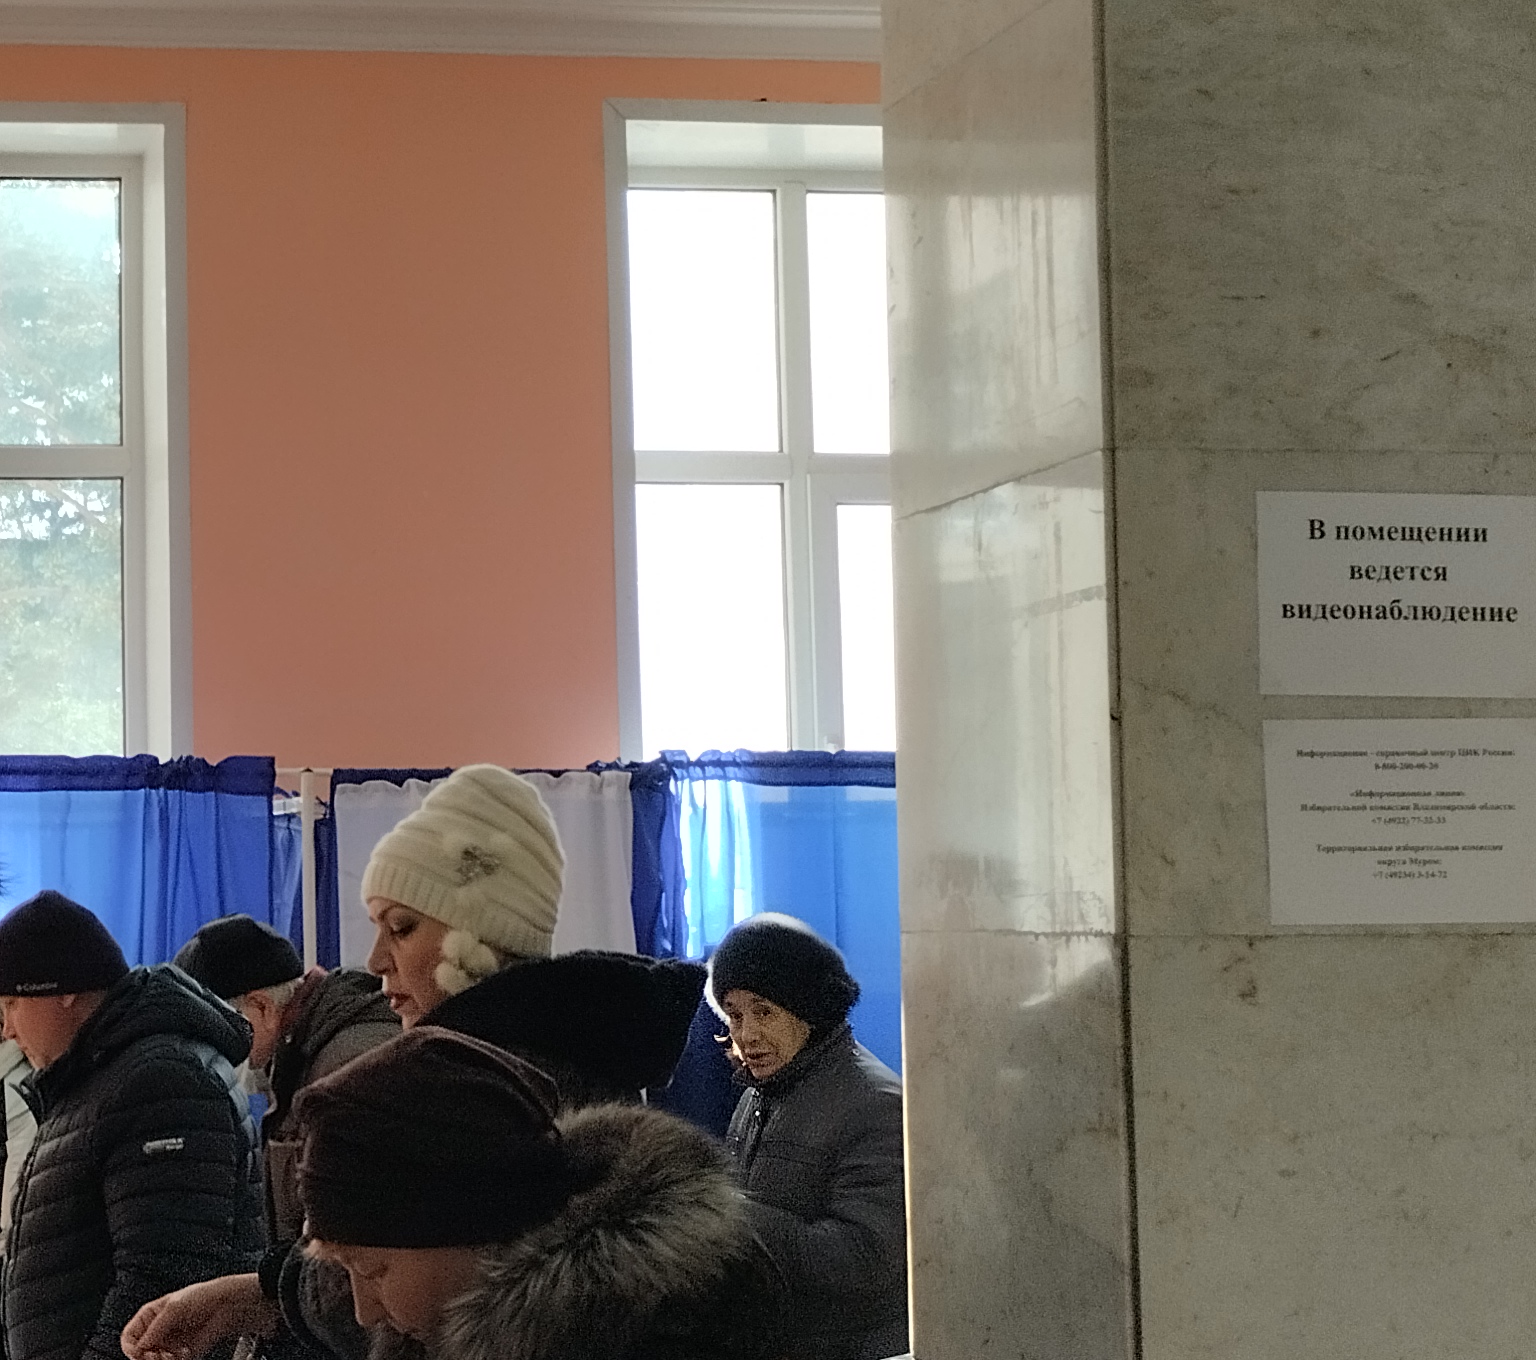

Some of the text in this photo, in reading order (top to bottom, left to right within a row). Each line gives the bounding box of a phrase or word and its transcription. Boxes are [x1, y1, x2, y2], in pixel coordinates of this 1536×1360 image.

[1307, 518, 1490, 544] В помещении
[1348, 564, 1449, 583] ведется
[1280, 598, 1520, 624] видеонаблюдение
